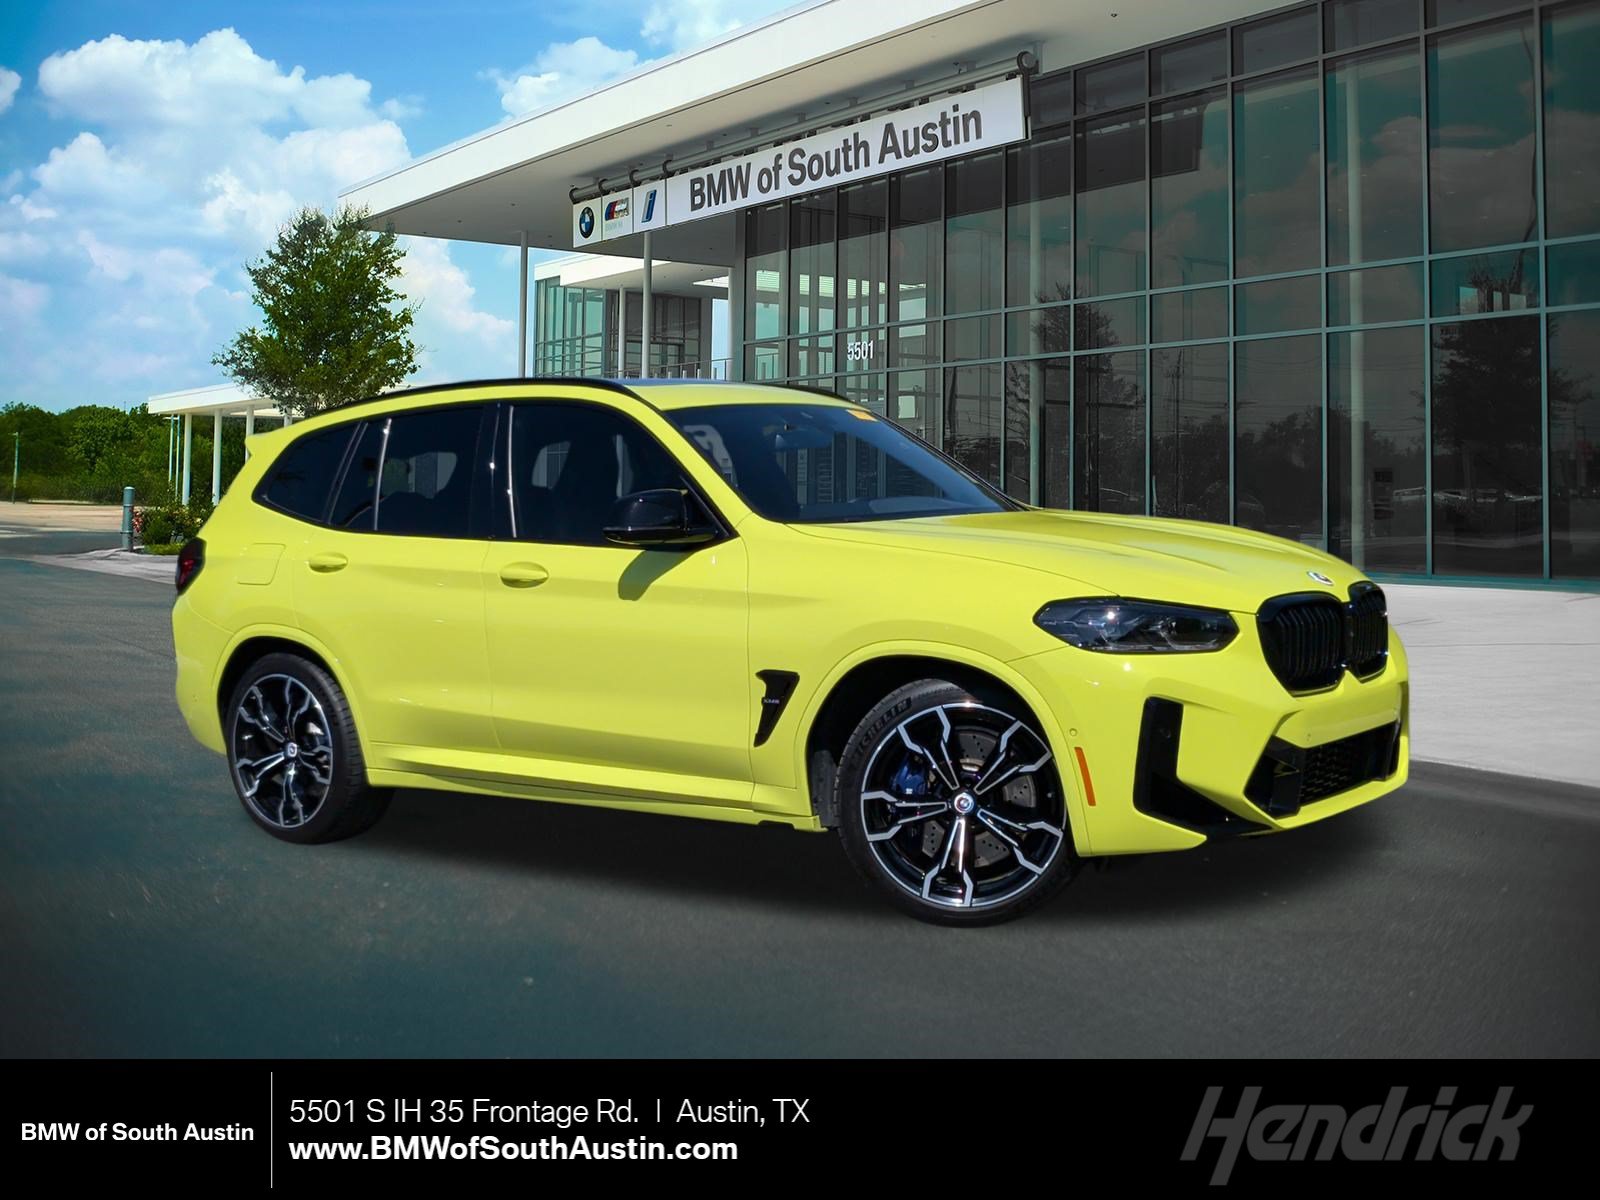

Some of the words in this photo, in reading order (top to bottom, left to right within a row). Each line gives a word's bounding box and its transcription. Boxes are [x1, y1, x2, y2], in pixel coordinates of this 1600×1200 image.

[690, 163, 751, 211] BMW
[757, 153, 783, 194] of
[787, 132, 870, 186] South
[878, 104, 982, 164] Austin
[847, 340, 873, 360] 5501
